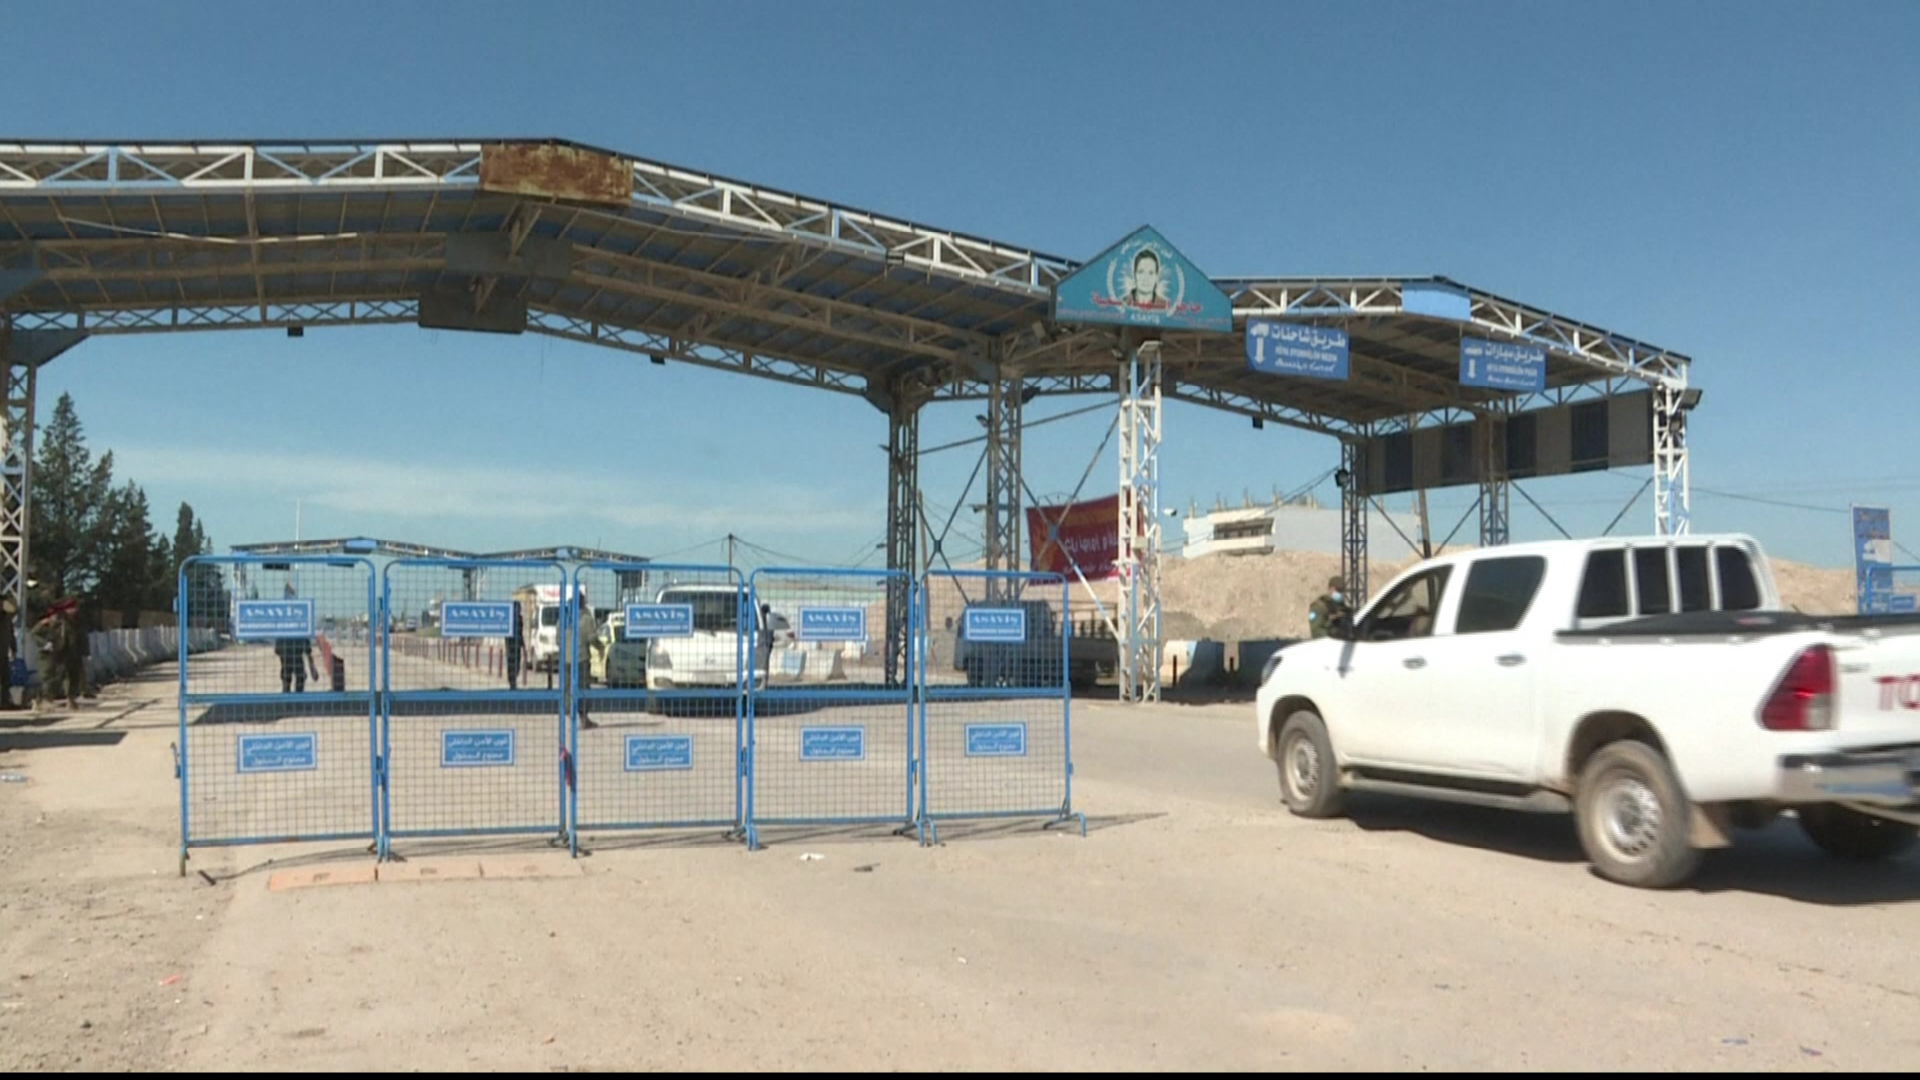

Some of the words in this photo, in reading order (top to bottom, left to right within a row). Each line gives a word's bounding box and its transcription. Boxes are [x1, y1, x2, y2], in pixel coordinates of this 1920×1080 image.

[1271, 324, 1311, 342] شاحنات
[1310, 329, 1346, 350] طريق
[1485, 343, 1514, 362] سيارات
[1514, 346, 1544, 364] طريق
